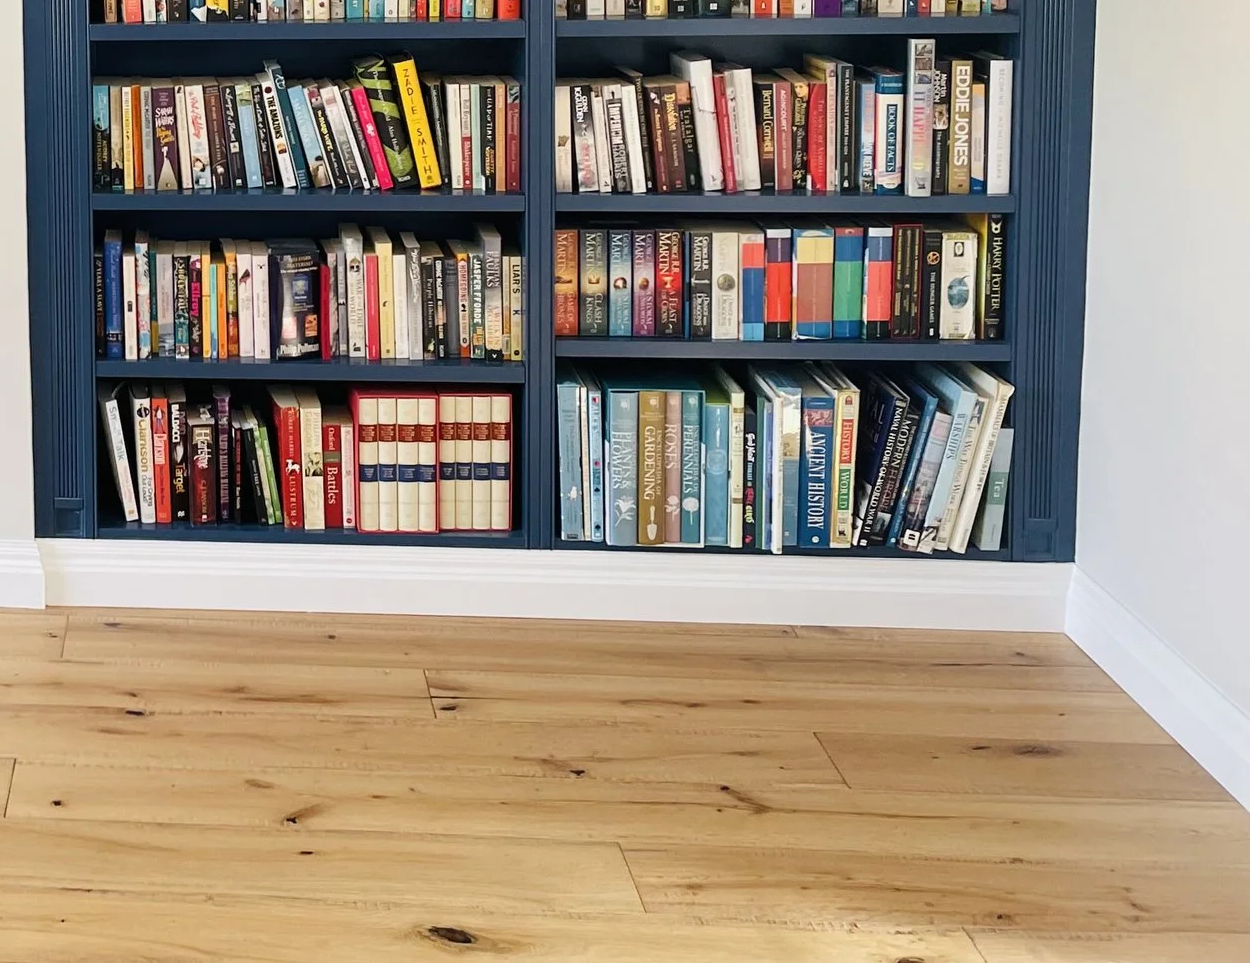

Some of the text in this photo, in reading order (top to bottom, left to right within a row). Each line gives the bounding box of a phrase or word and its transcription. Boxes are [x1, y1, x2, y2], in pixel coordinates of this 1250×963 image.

[155, 107, 173, 117] SARAH
[155, 116, 174, 127] WATERS
[266, 96, 283, 140] THE AMAZONS
[487, 114, 491, 122] OF
[574, 87, 584, 123] IGGULDEN
[762, 90, 773, 152] Bernard Cornwell
[954, 66, 970, 166] EDDIE JONES
[683, 109, 693, 153] Trafalgar
[887, 106, 896, 172] BOOK OF FACTS
[416, 128, 432, 174] SMITH
[463, 141, 471, 176] Shakespeare
[618, 144, 627, 178] ROBERT
[863, 154, 873, 177] REEVE
[486, 251, 494, 287] FAULKS
[659, 232, 670, 275] MARTIN
[693, 236, 703, 271] MARTIN
[473, 258, 482, 324] JASPER FFORDE
[512, 264, 520, 294] LIAR'S
[991, 237, 1003, 310] HARRY POTTER
[191, 282, 200, 317] Ellroy
[594, 293, 603, 323] CLASH
[668, 297, 677, 323] FEAST
[280, 343, 319, 356] Philip Pullman
[171, 404, 180, 443] BALDACCI
[890, 408, 903, 431] NAVAL
[946, 413, 968, 460] WARSHIPS
[664, 424, 677, 469] ROSES
[683, 425, 694, 494] PERENNIALS
[841, 421, 852, 462] HISTORY
[881, 433, 897, 466] HISTORY
[173, 463, 185, 494] Target
[612, 432, 622, 489] FLOWERS
[644, 426, 655, 500] GARDENING
[879, 419, 912, 513] MODERN EUROPE
[879, 467, 887, 478] OF
[949, 425, 975, 505] THE WAY THINGS WORK
[327, 467, 338, 504] Battles
[807, 432, 825, 529] ANCIENT HISTORY
[839, 471, 849, 508] WORLD
[871, 480, 884, 507] WORLD
[993, 478, 1004, 498] Tea
[866, 508, 875, 525] WAR
